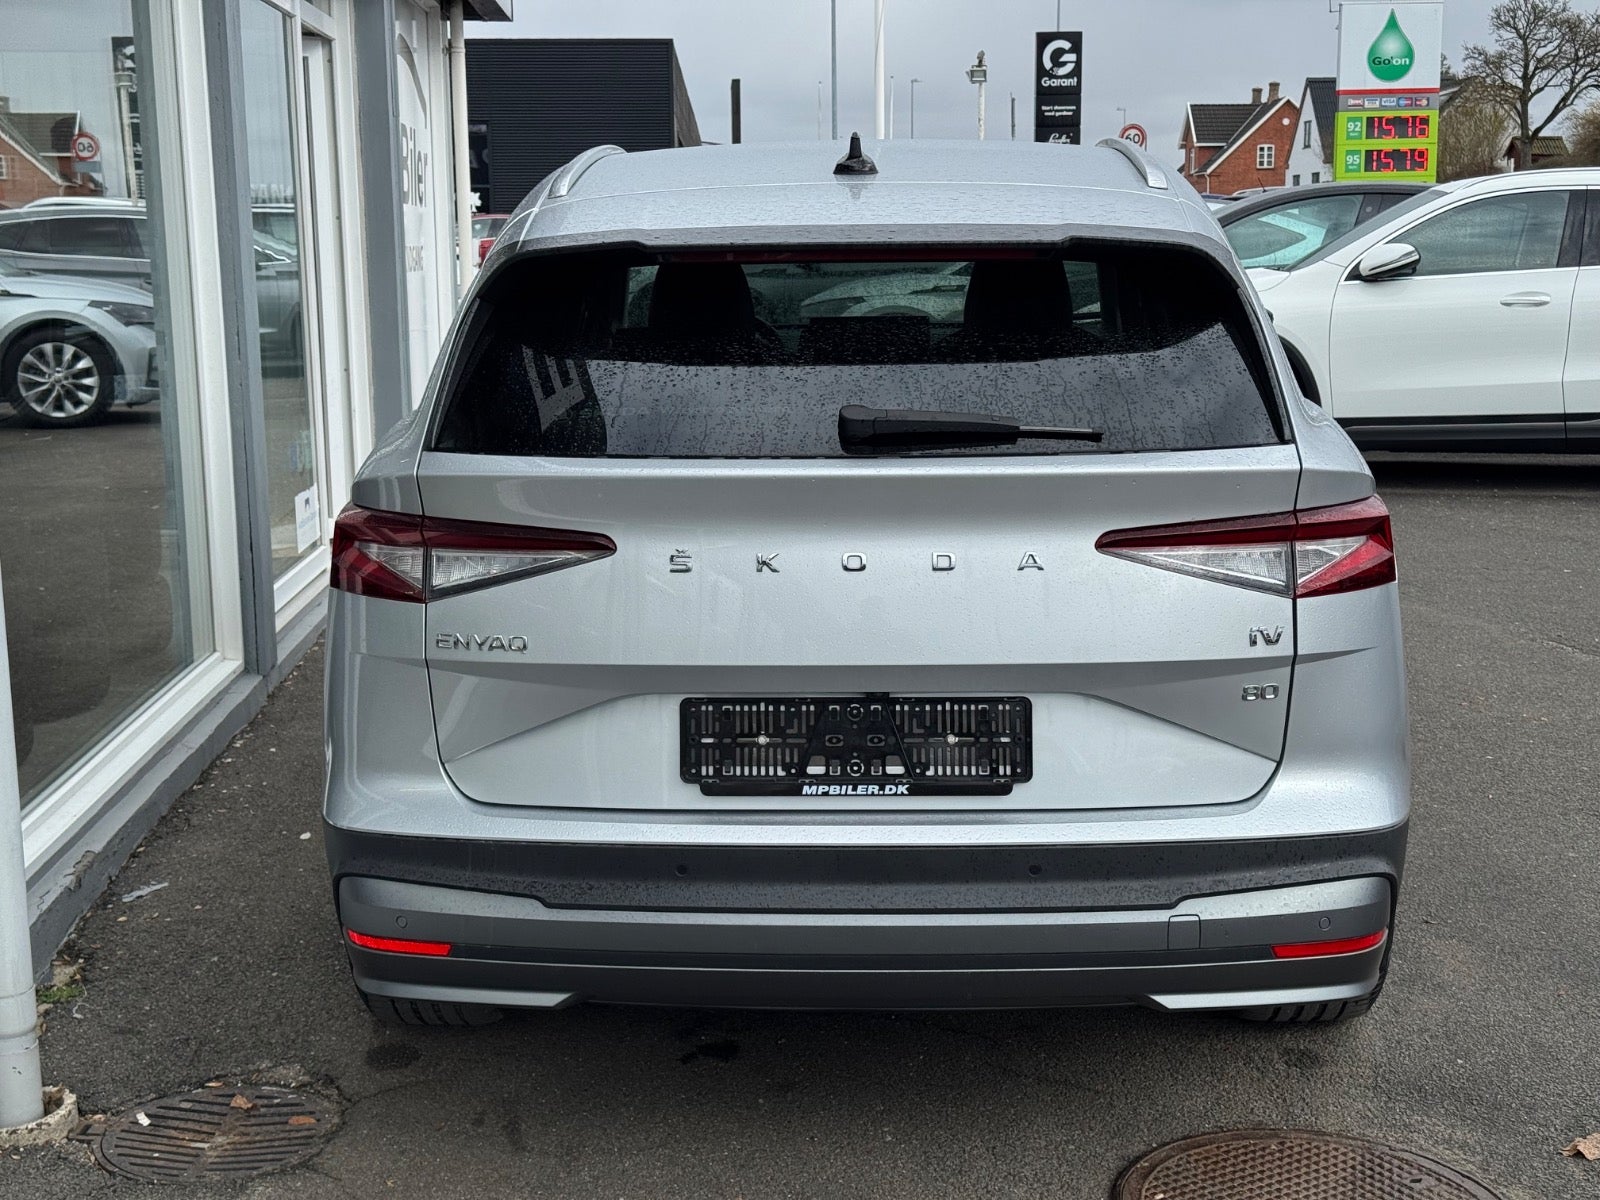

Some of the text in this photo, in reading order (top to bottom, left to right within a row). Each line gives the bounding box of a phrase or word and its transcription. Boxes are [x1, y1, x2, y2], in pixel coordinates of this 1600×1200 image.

[1041, 76, 1077, 87] Garant
[1347, 122, 1361, 132] 92
[400, 122, 428, 209] Biler
[1346, 154, 1360, 164] 95
[668, 548, 1045, 573] ŠKODA
[435, 633, 529, 655] ENYAQ
[1241, 683, 1280, 702] 80
[801, 784, 911, 795] MPBILER.DK
